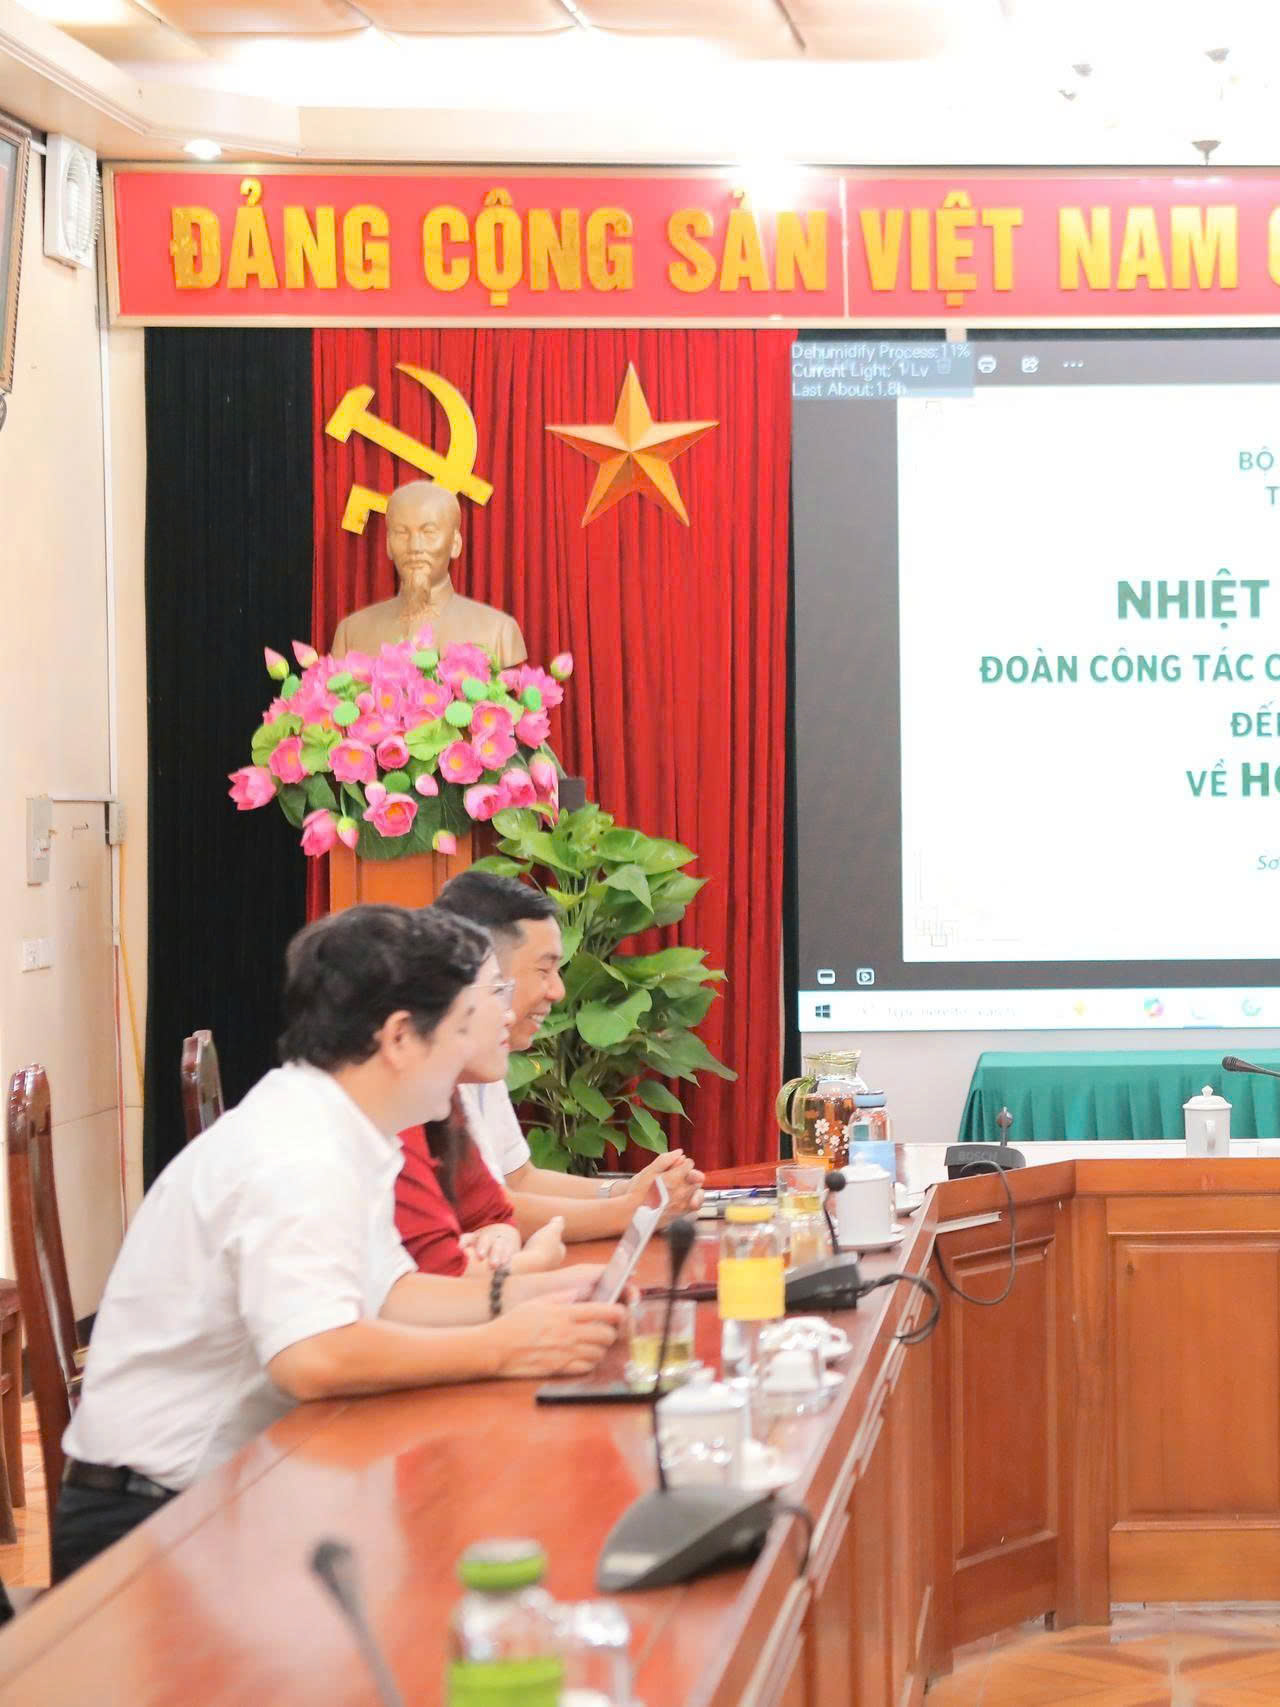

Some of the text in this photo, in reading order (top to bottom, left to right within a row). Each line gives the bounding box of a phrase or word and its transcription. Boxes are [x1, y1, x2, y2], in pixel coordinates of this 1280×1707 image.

[170, 177, 391, 290] ĐẢNG
[423, 187, 633, 306] CỘNG
[668, 186, 828, 294] SẢN
[860, 190, 1023, 306] VIỆT
[1059, 205, 1238, 290] NAM
[792, 344, 875, 361] Dehumidify
[792, 364, 845, 378] Current
[851, 363, 891, 381] Light:
[792, 383, 822, 396] Last
[1117, 568, 1270, 629] NHIỆT
[979, 648, 1078, 683] ĐOÀN
[1089, 647, 1181, 682] CÔNG
[1193, 647, 1254, 682] TÁC
[1186, 759, 1228, 797] VỀ
[958, 1151, 998, 1161] BOSCH
